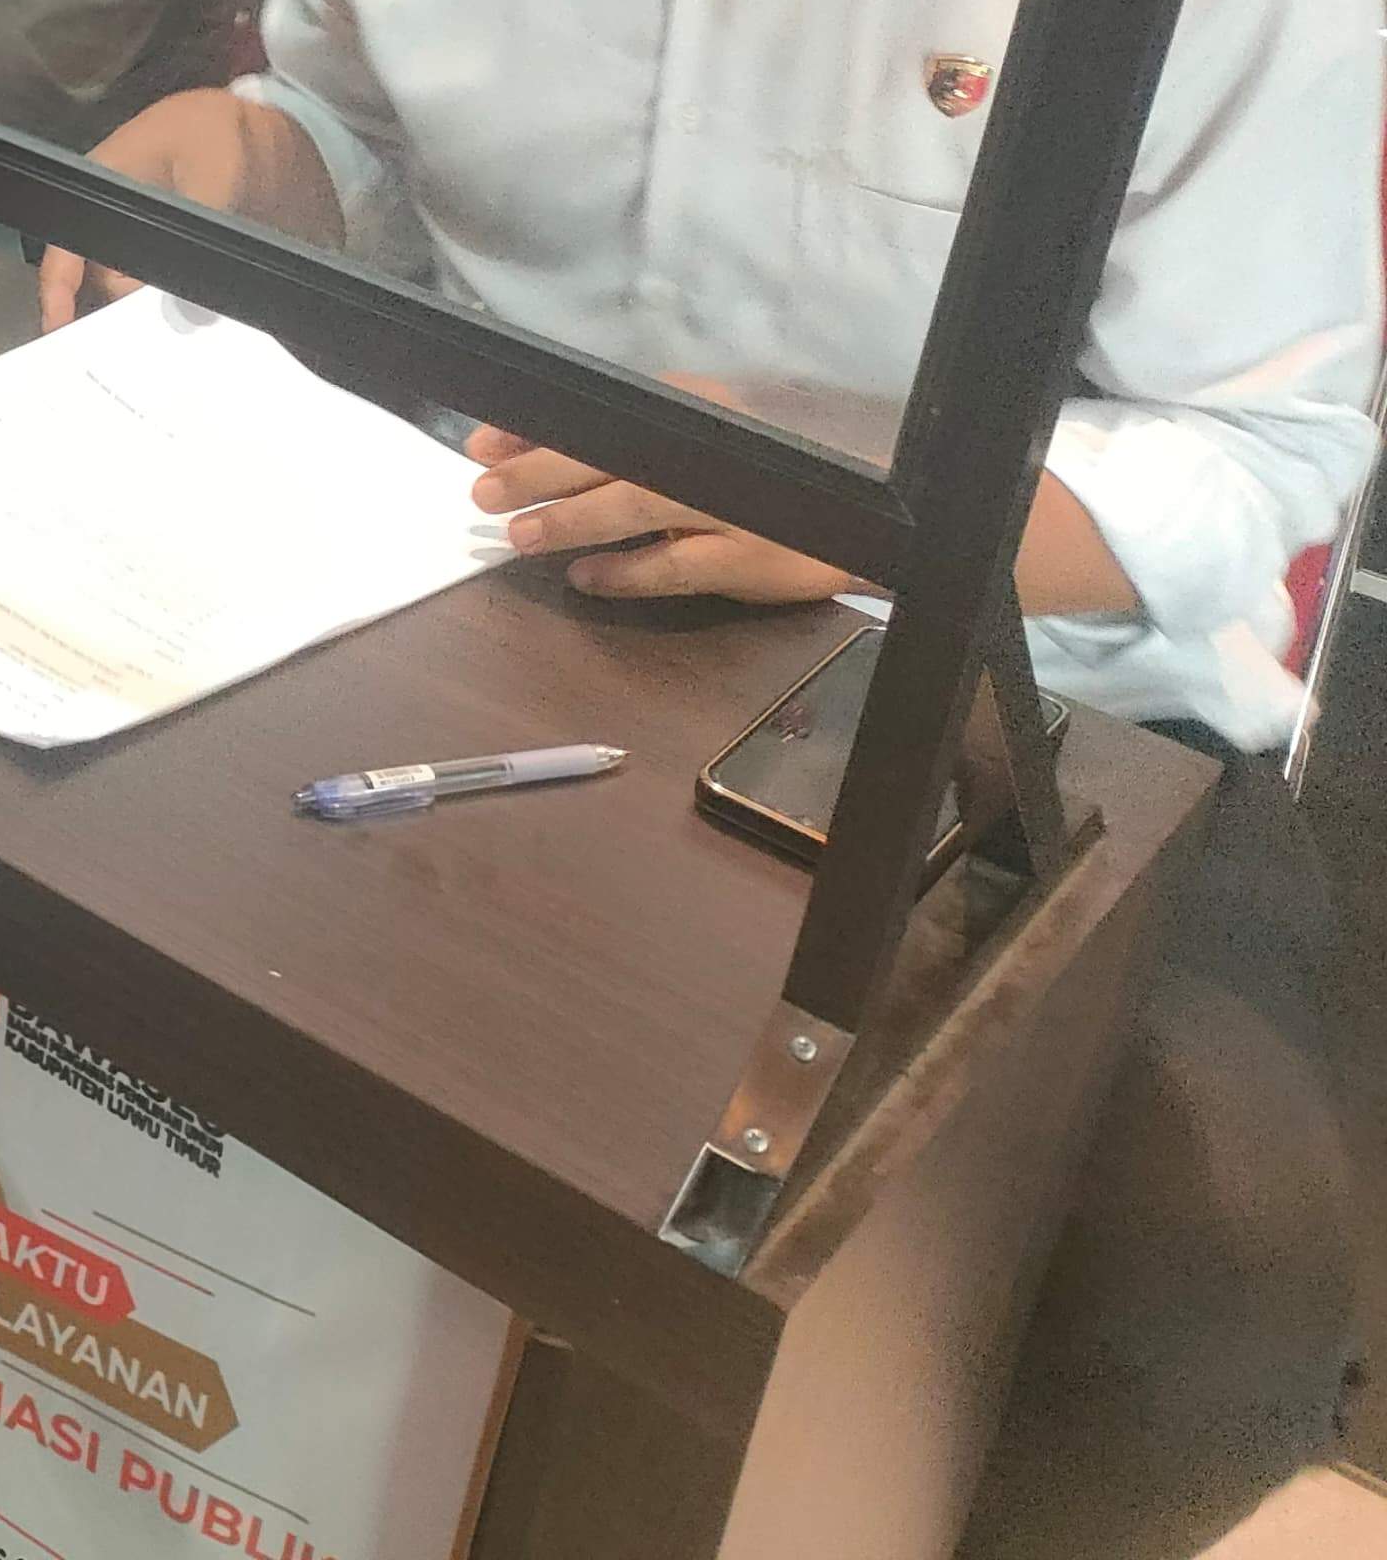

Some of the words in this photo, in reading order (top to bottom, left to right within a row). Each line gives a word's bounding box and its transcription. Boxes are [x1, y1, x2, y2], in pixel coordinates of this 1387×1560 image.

[4, 1028, 105, 1106] KABUPATEN
[106, 1092, 162, 1141] LUWU
[164, 1127, 222, 1179] TIMUR
